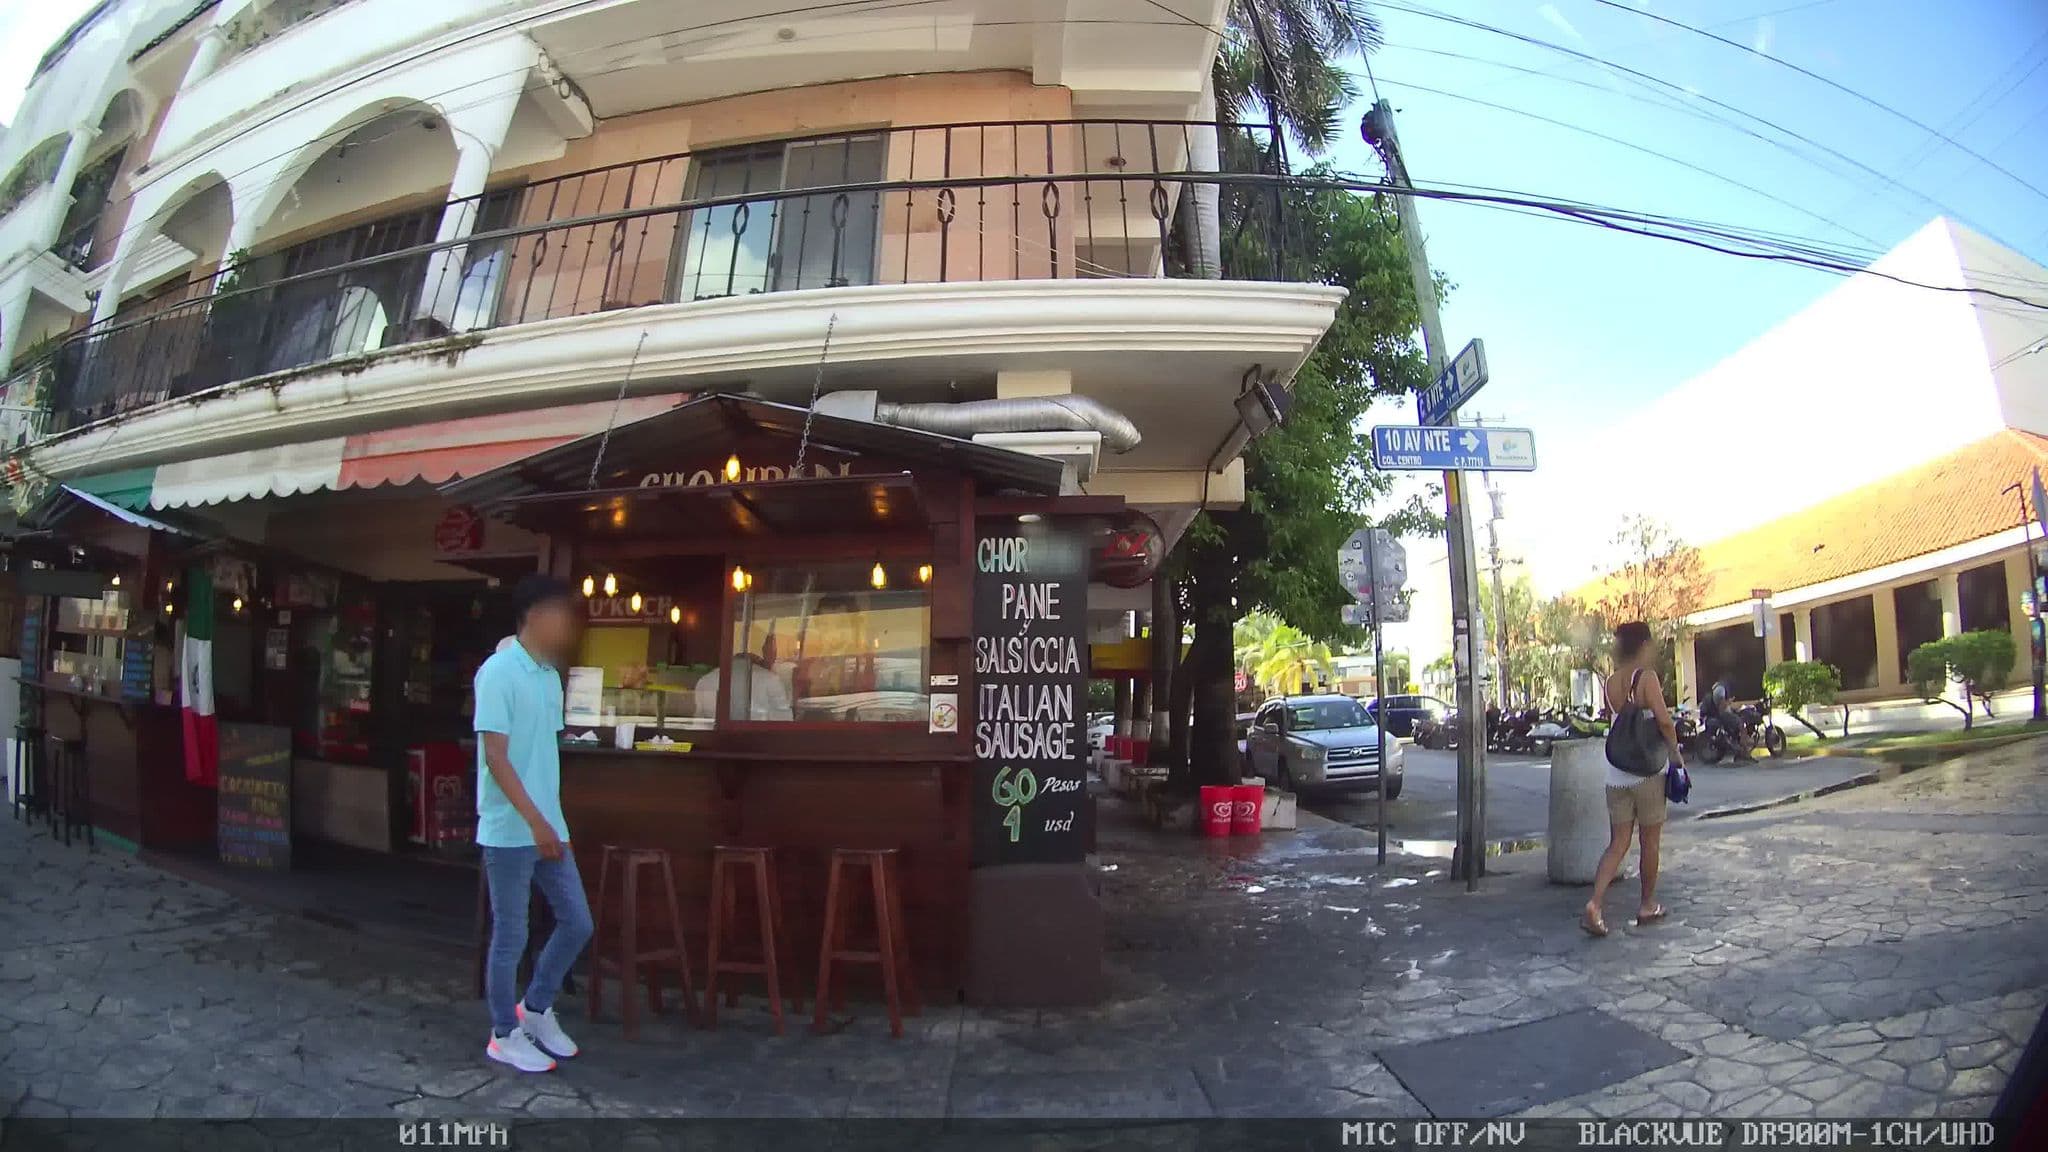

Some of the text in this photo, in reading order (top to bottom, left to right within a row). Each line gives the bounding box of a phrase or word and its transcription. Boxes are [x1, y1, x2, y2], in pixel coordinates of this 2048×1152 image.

[1385, 429, 1451, 452] 10 AV NTE
[1397, 455, 1422, 466] CENTRO
[1002, 583, 1060, 619] PANE
[975, 636, 1081, 674] SALSICCIA
[979, 684, 1073, 721] ITALIAN
[975, 721, 1075, 760] SAUSAGE
[992, 766, 1081, 807] 60 Pesos
[1044, 811, 1075, 832] usd
